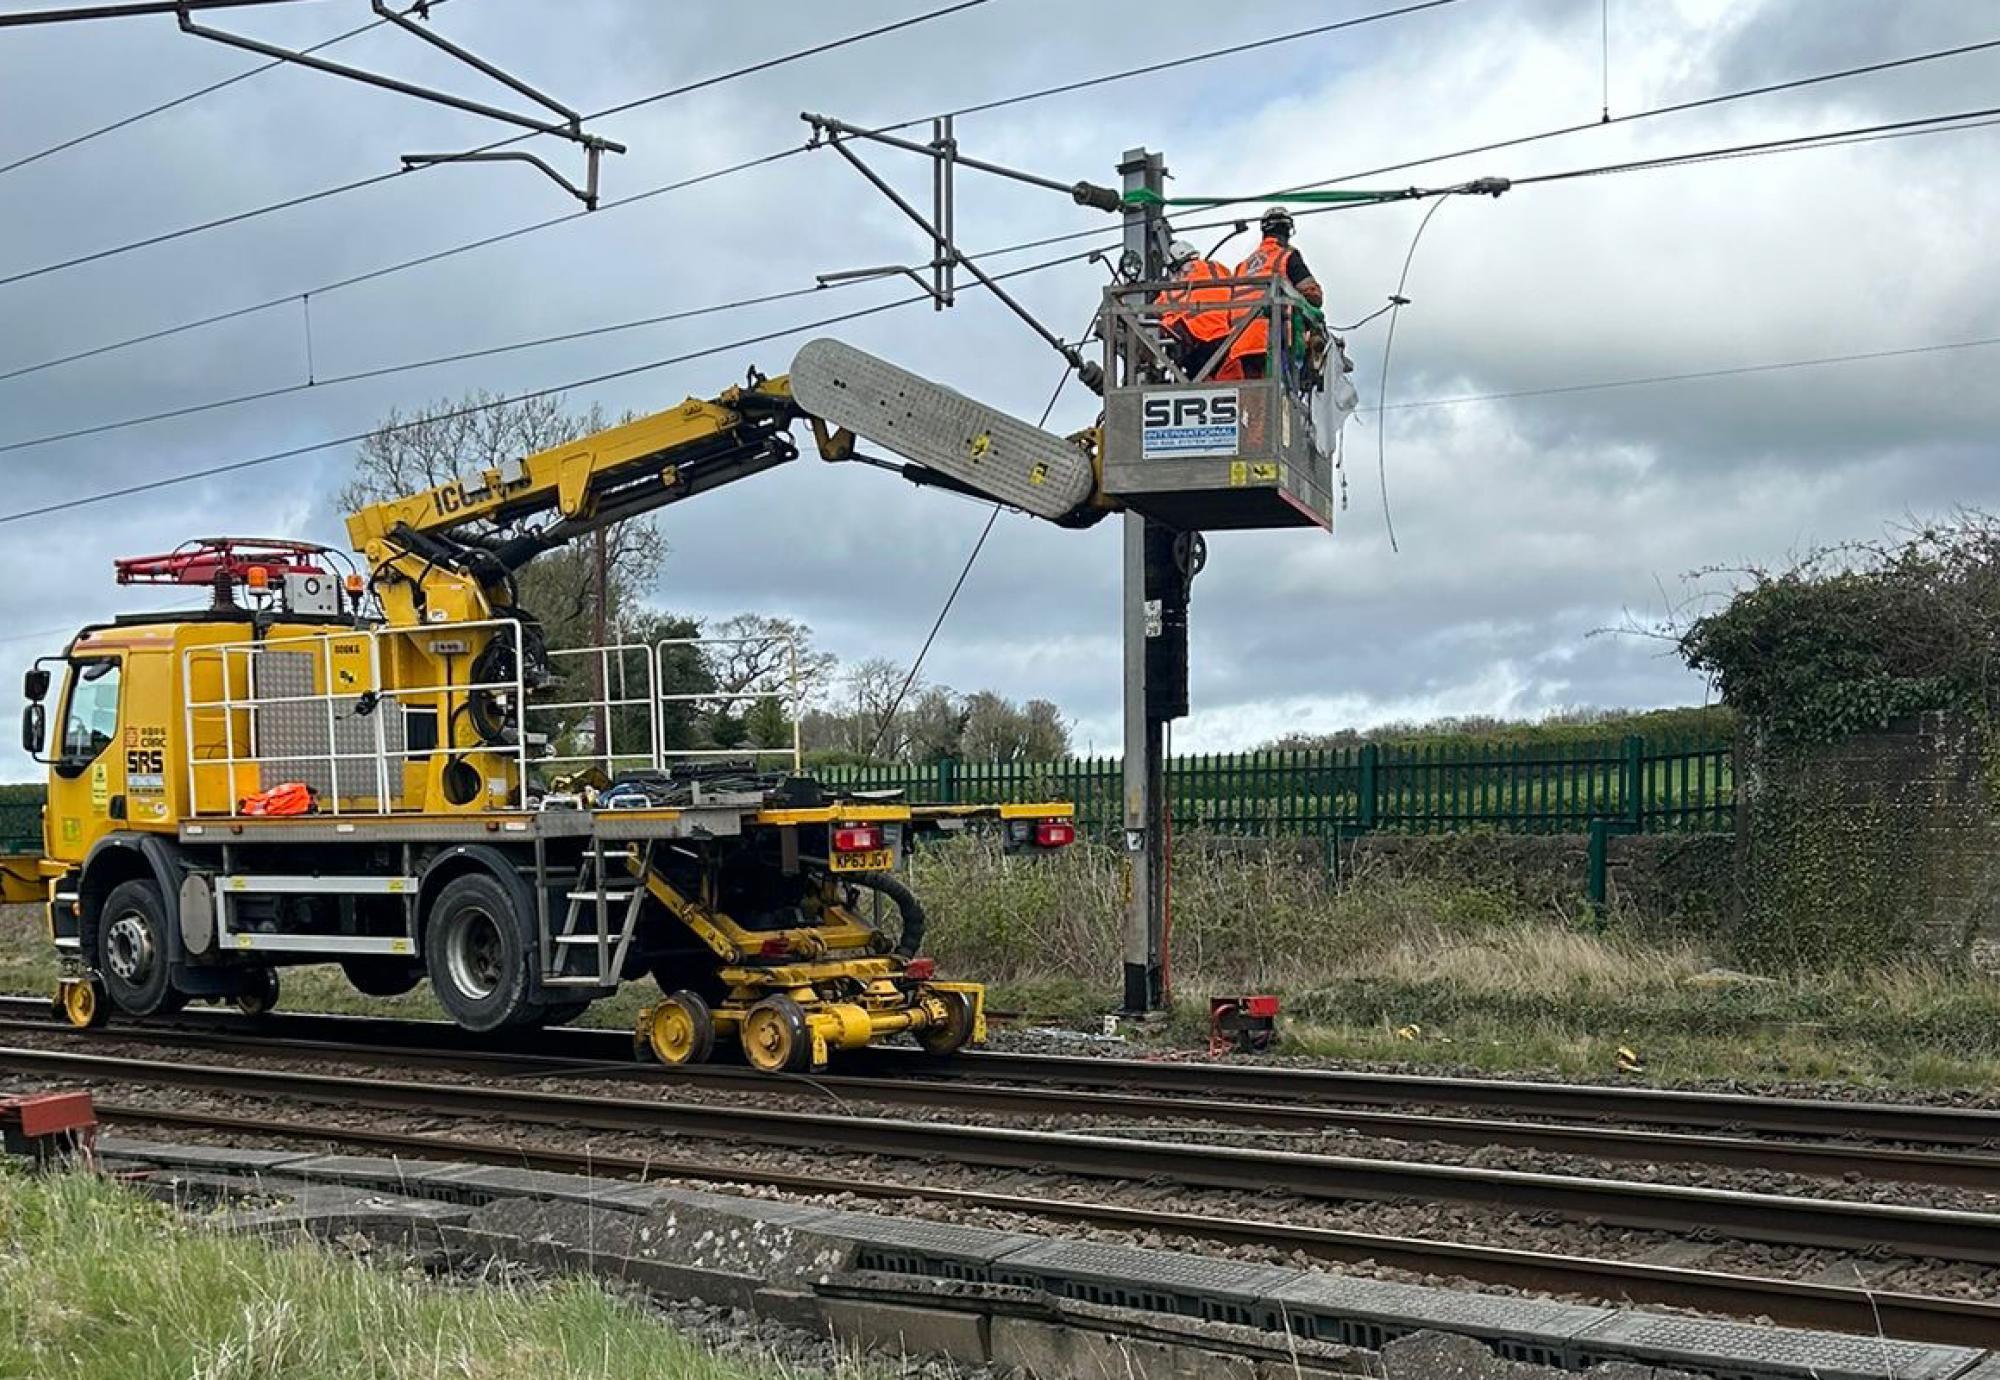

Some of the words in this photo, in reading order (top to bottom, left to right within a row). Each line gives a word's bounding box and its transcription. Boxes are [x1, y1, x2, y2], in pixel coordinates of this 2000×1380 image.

[1145, 396, 1237, 427] SRS
[127, 750, 164, 774] SRS
[836, 853, 866, 868] KP63
